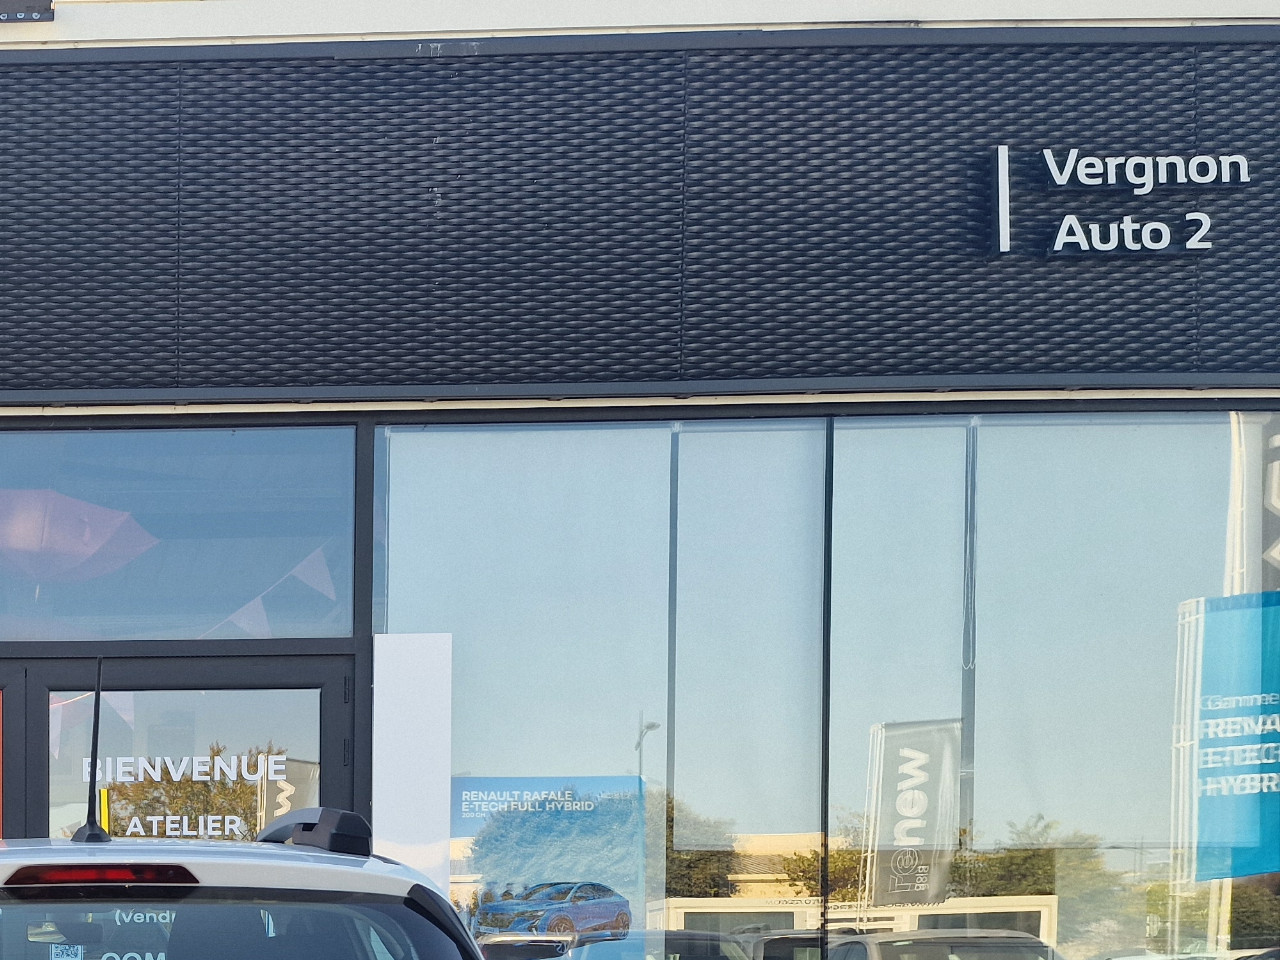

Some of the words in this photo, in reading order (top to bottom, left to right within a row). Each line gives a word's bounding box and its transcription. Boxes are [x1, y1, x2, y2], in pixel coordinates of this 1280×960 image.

[1043, 148, 1250, 195] Vergnon
[1053, 214, 1170, 251] Auto
[1185, 212, 1212, 249] 2
[82, 755, 287, 783] BIENVENUE
[462, 790, 521, 801] RENAULT
[523, 790, 573, 801] RAFALE
[462, 801, 508, 812] E-TECH
[510, 801, 543, 812] FULL
[545, 801, 595, 811] HYBRID
[126, 815, 242, 836] ATELIER
